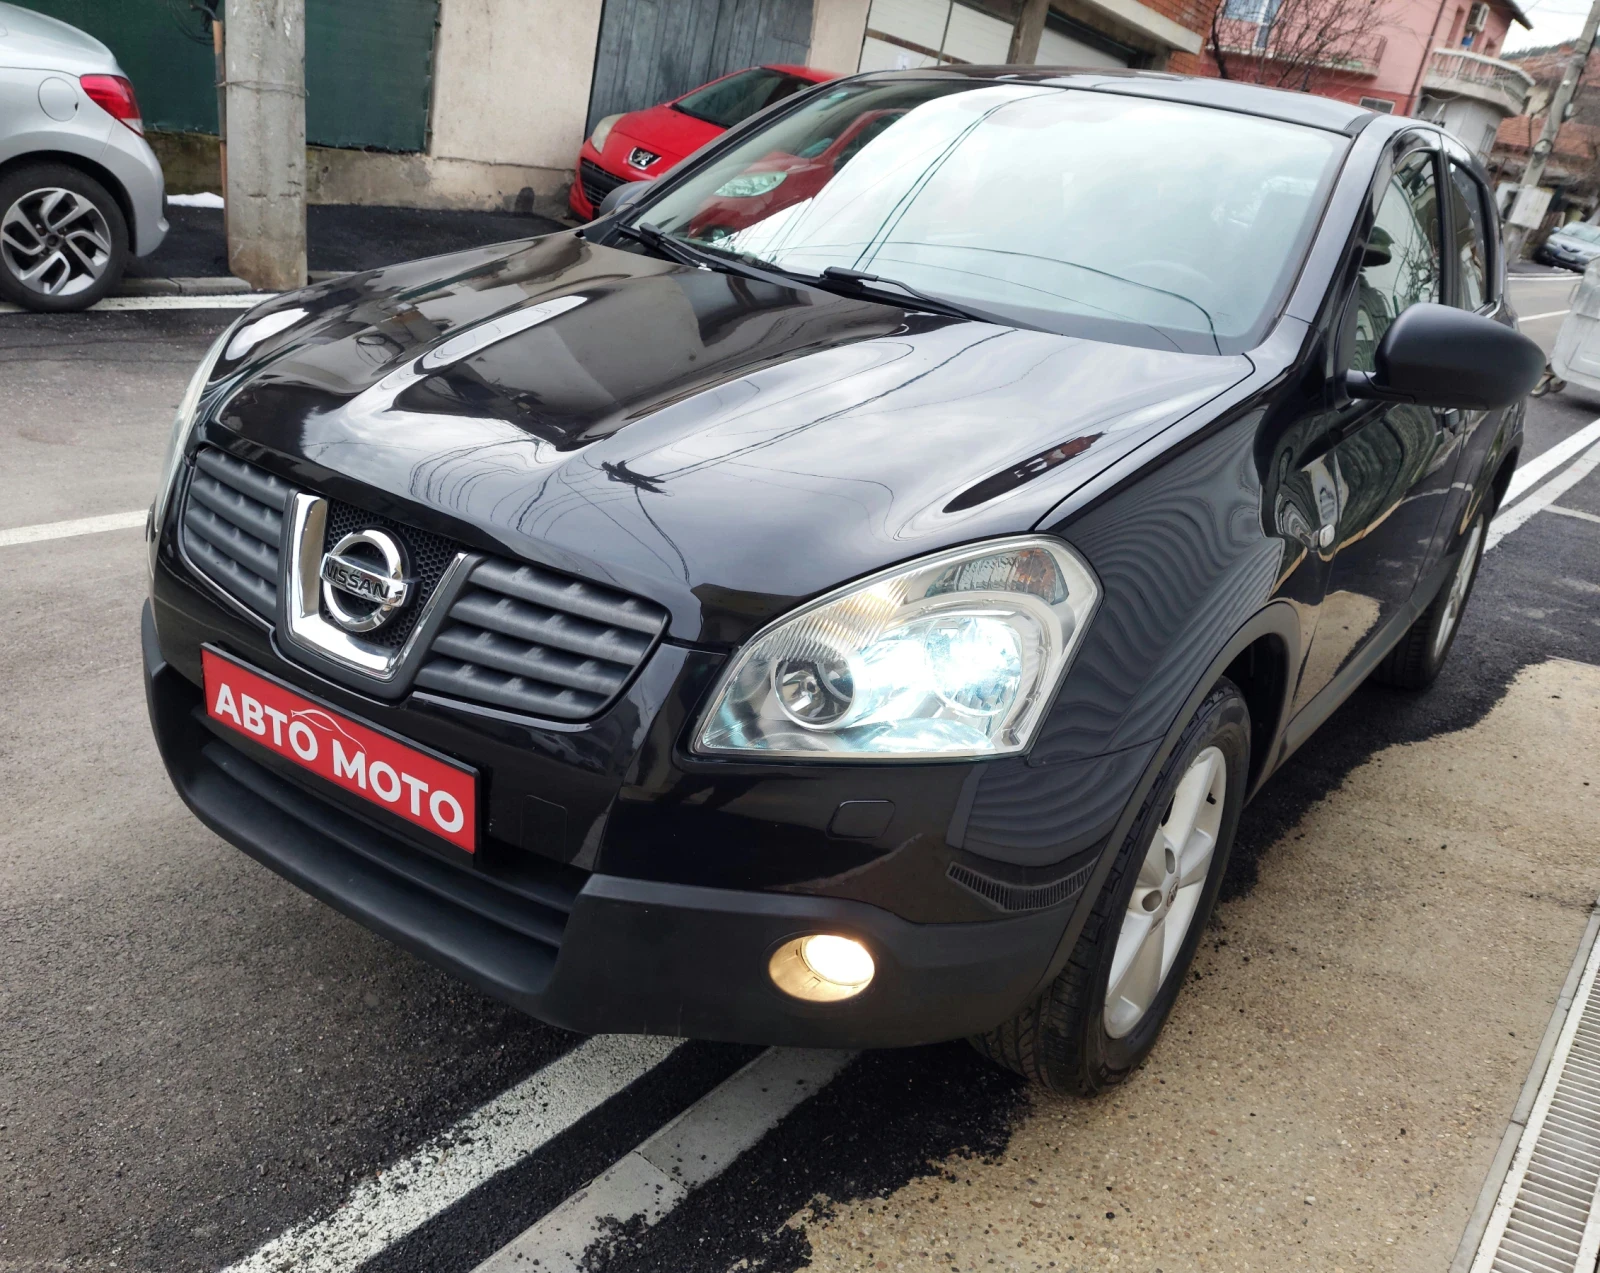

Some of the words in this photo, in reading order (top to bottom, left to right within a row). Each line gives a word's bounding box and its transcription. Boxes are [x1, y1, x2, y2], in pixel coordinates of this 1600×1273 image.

[322, 562, 390, 599] NISSAN
[215, 683, 319, 762] АВТО
[332, 739, 465, 833] МОТО
